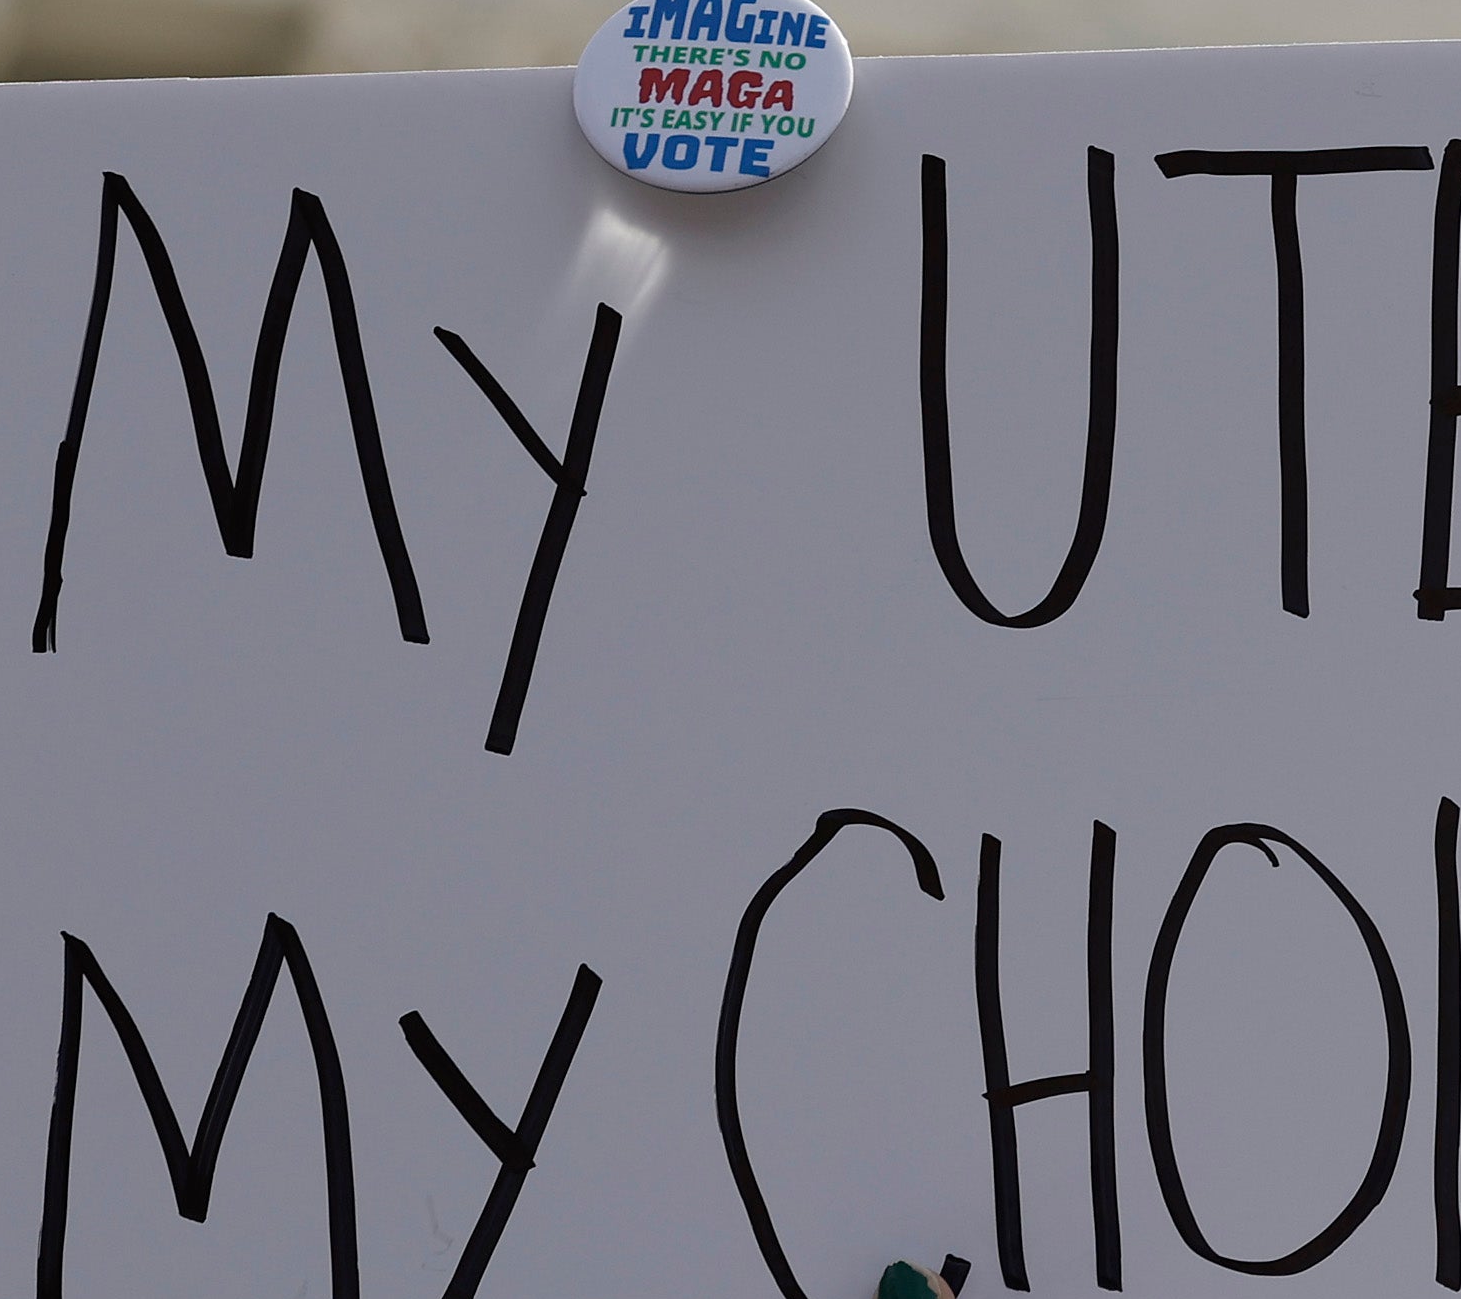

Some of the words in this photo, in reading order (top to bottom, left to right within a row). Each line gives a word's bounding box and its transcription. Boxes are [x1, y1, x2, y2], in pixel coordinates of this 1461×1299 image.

[633, 45, 752, 68] THERE'S
[759, 51, 806, 70] NO
[639, 68, 794, 111] MAGA
[610, 108, 654, 128] IT'S
[662, 109, 725, 132] EASY
[730, 113, 753, 132] IF
[762, 114, 815, 138] YOU
[622, 132, 775, 178] VOTE
